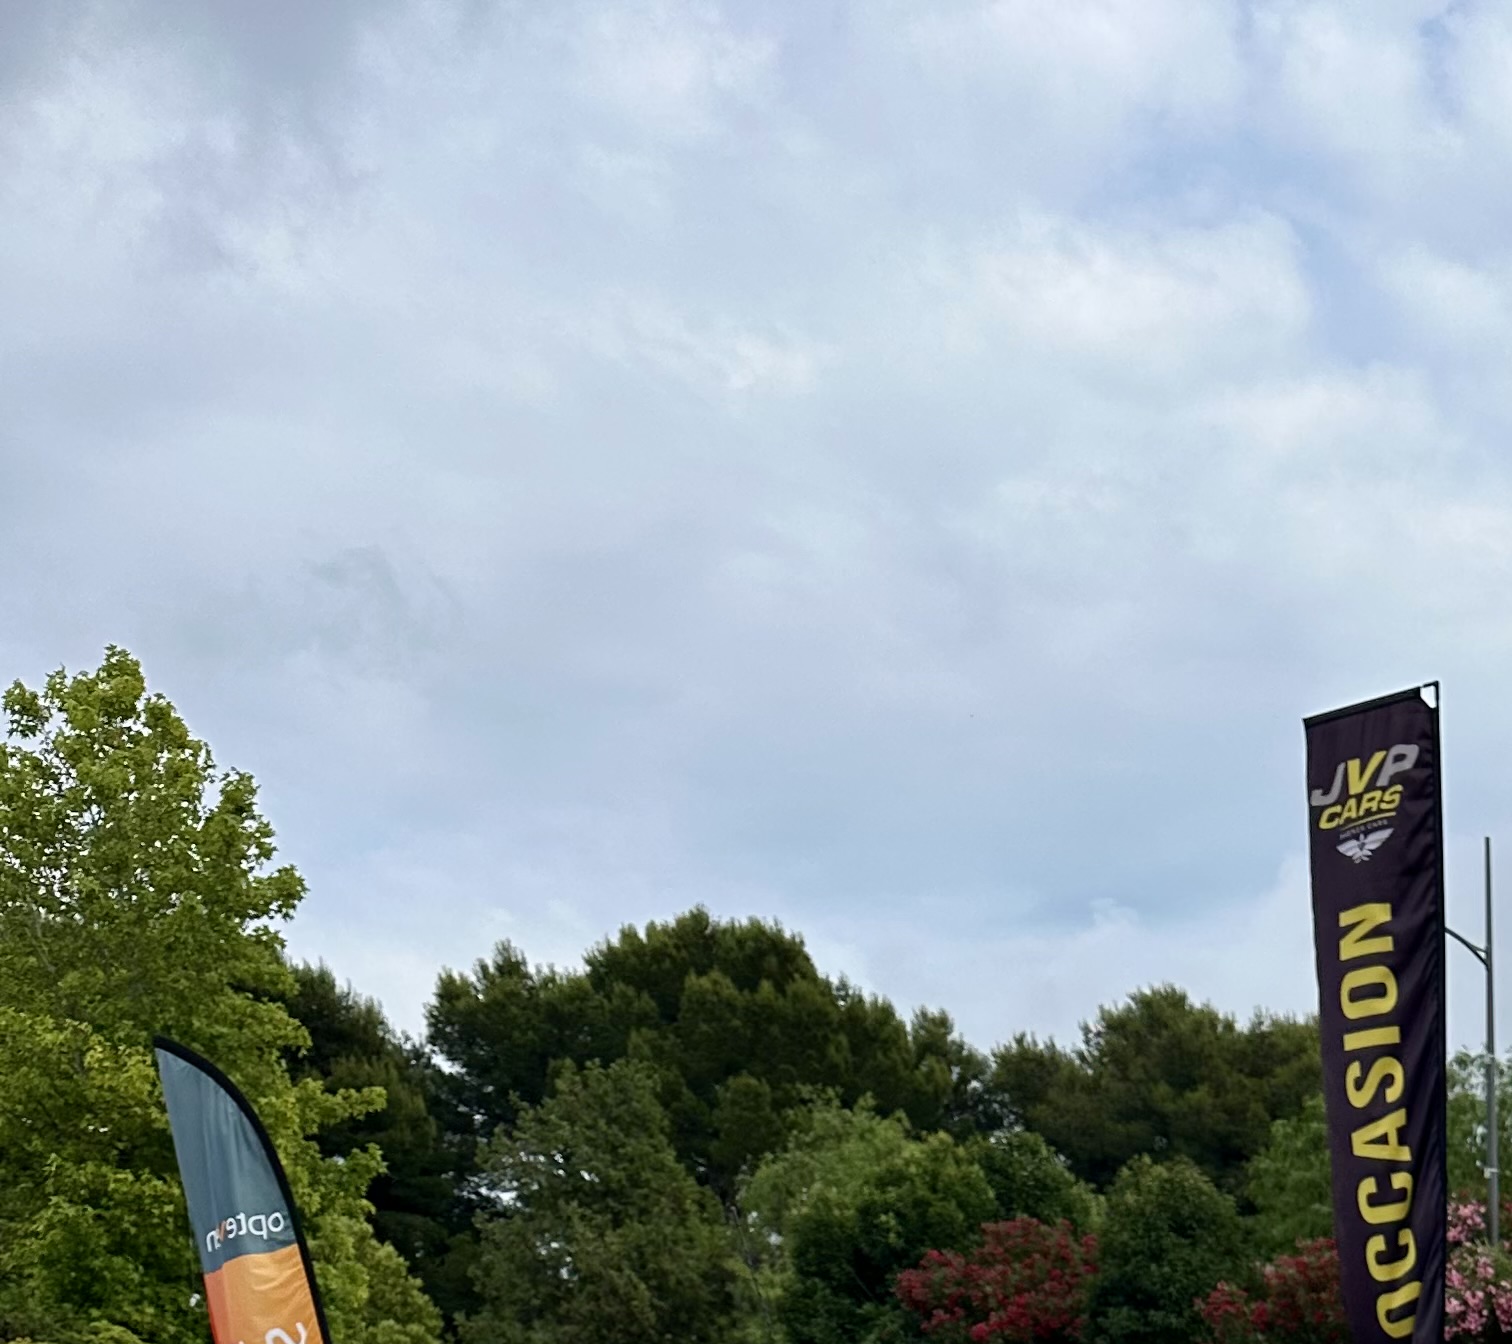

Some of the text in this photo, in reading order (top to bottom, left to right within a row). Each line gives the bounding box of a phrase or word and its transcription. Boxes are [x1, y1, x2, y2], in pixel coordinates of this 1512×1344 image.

[1310, 744, 1419, 806] JVP
[1319, 784, 1403, 830] CARS
[1339, 902, 1424, 1339] OCCASION
